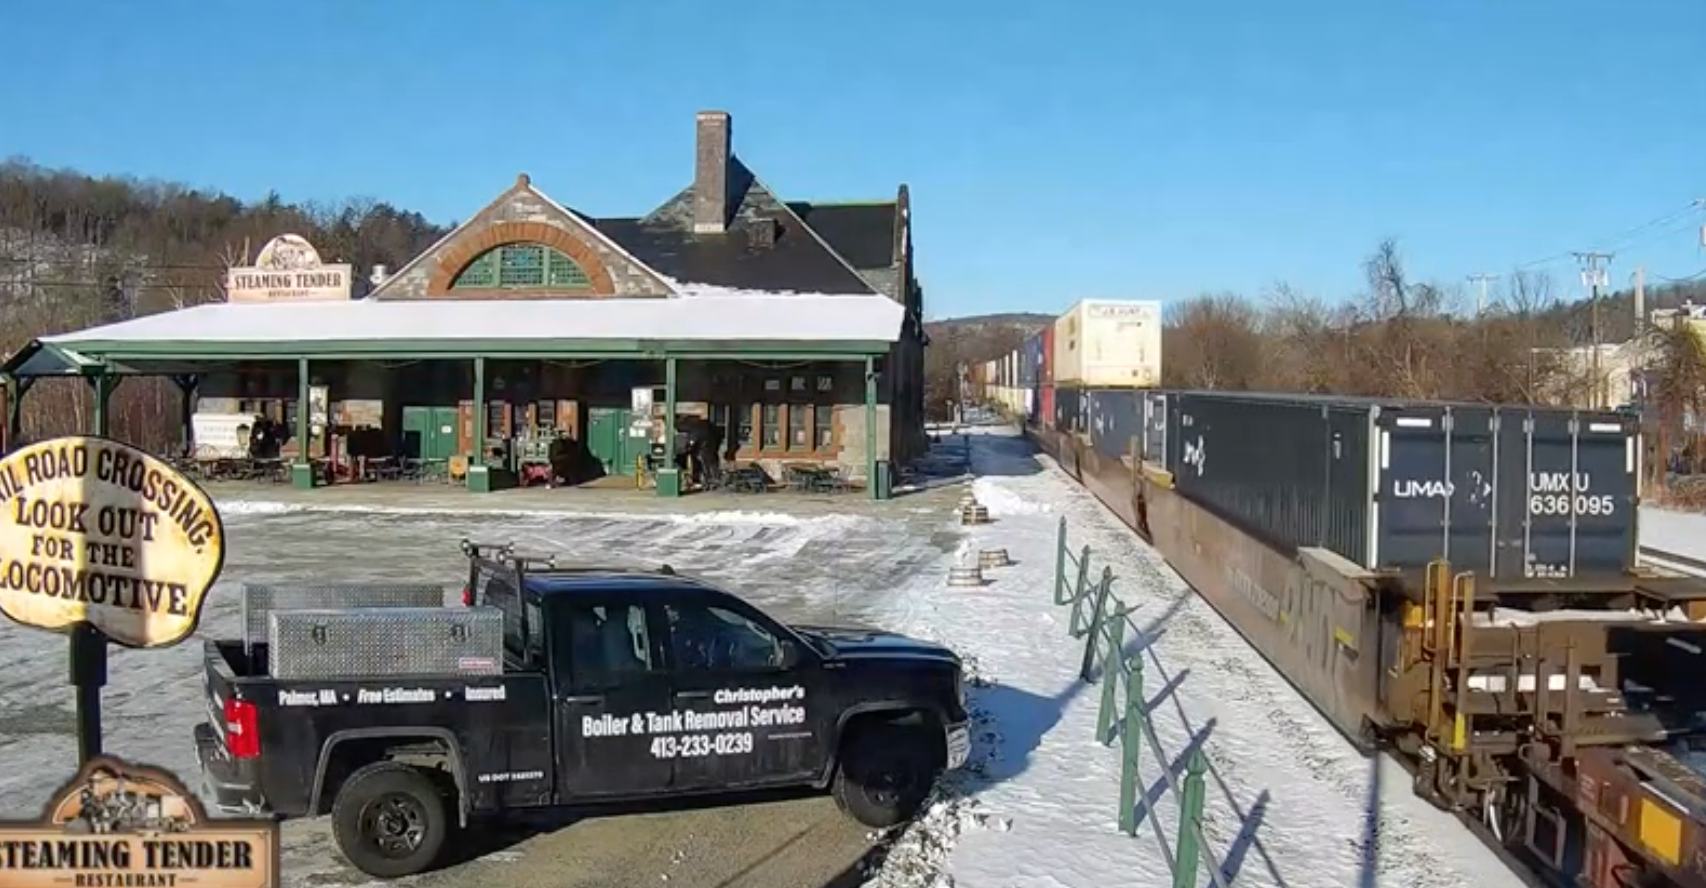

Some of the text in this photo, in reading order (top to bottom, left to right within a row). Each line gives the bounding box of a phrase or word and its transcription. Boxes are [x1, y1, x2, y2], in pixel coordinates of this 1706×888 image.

[234, 272, 341, 290] STEAMING TENDER
[24, 446, 88, 487] ROAD
[16, 497, 159, 542] LOOK OUT
[31, 534, 135, 568] FOR THE
[357, 686, 436, 704] Free Estimates
[714, 685, 805, 704] Christopher's
[582, 703, 805, 738] Boiler & Tank Removal Service
[650, 732, 755, 759] 413-233-0239
